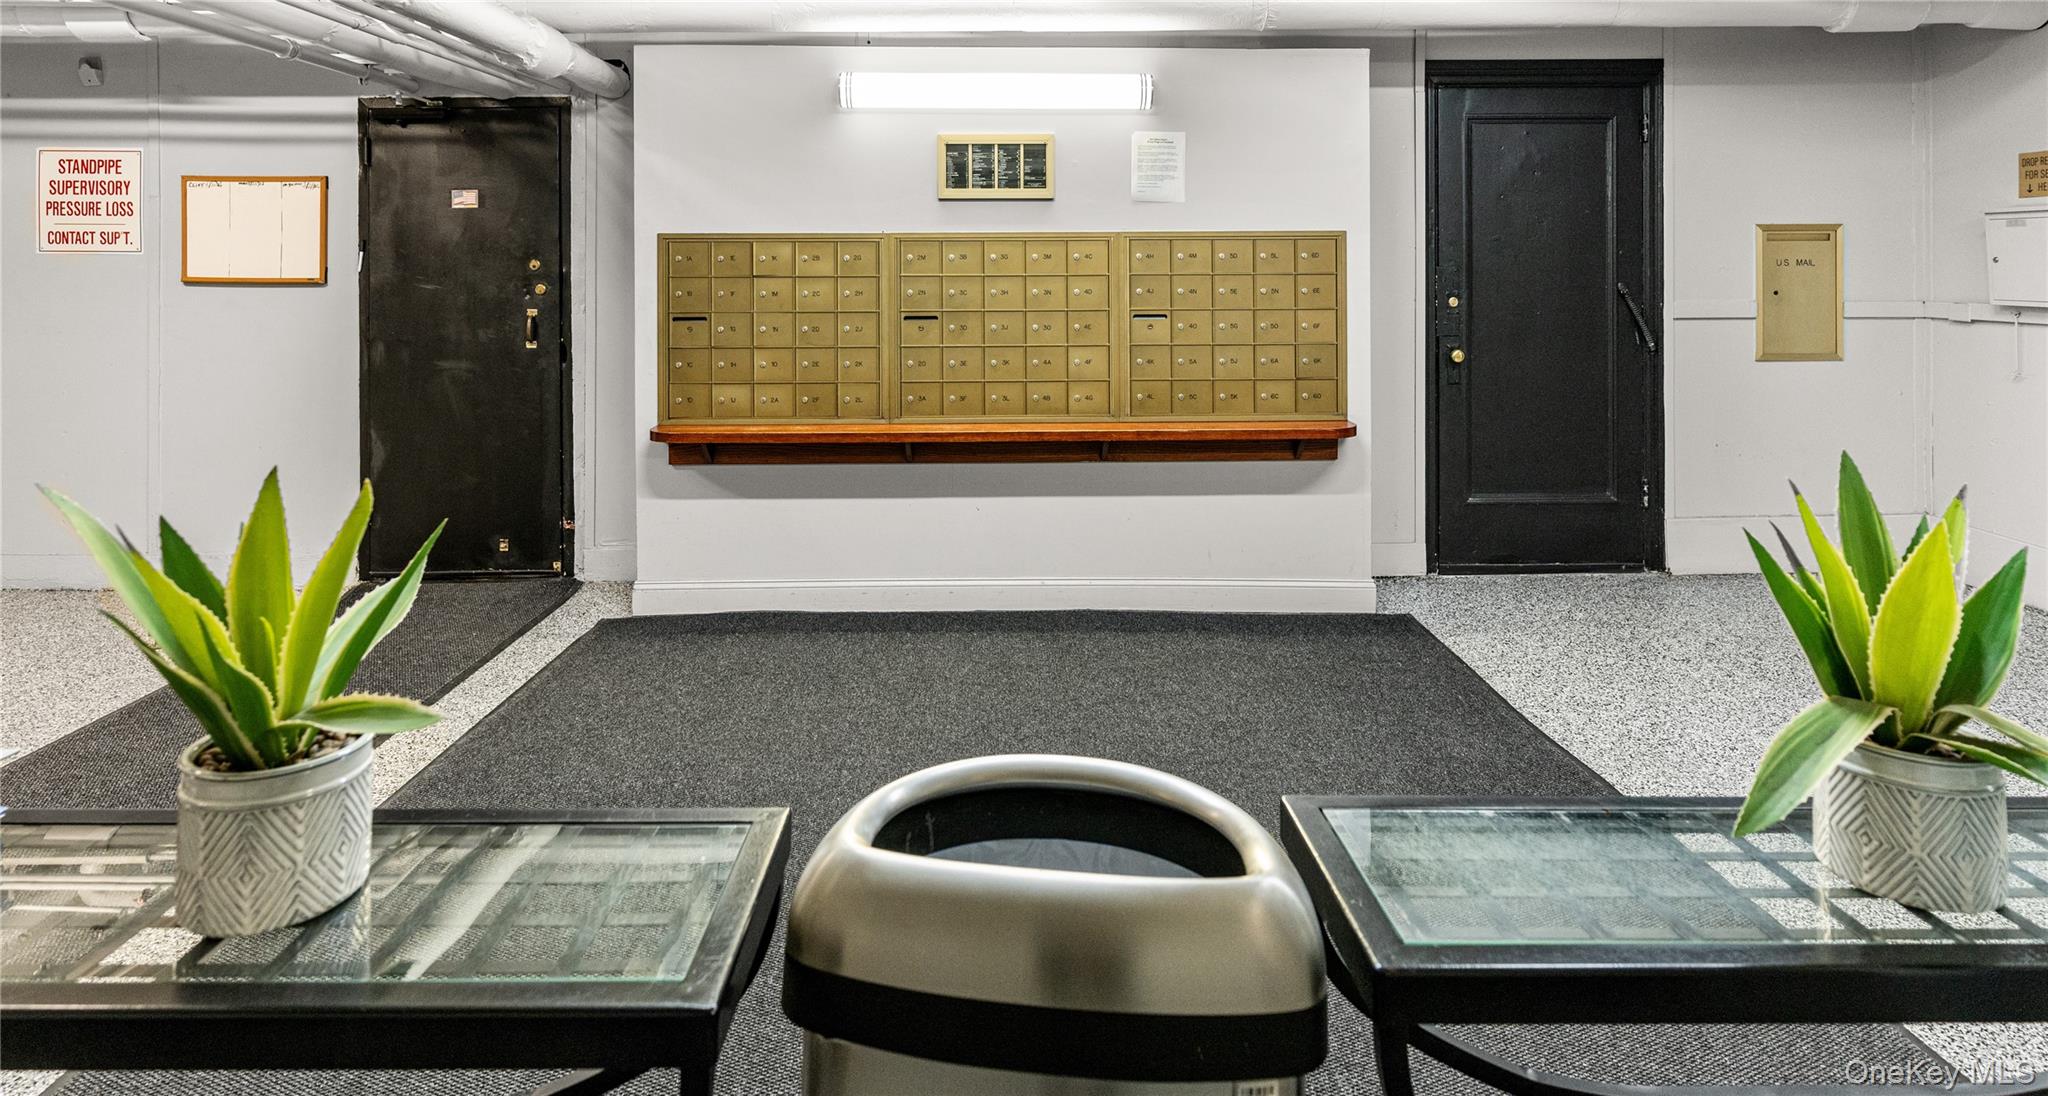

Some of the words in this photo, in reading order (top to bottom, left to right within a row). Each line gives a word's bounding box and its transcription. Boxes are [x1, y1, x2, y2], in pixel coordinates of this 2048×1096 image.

[57, 158, 122, 175] STANDPIPE
[2021, 157, 2039, 168] DROP
[2025, 170, 2039, 180] FOR
[49, 180, 131, 196] SUPERVISORY
[46, 201, 102, 217] PRESSURE
[106, 201, 134, 217] LOSS
[47, 231, 96, 246] CONTACT
[1795, 258, 1816, 267] MAIL
